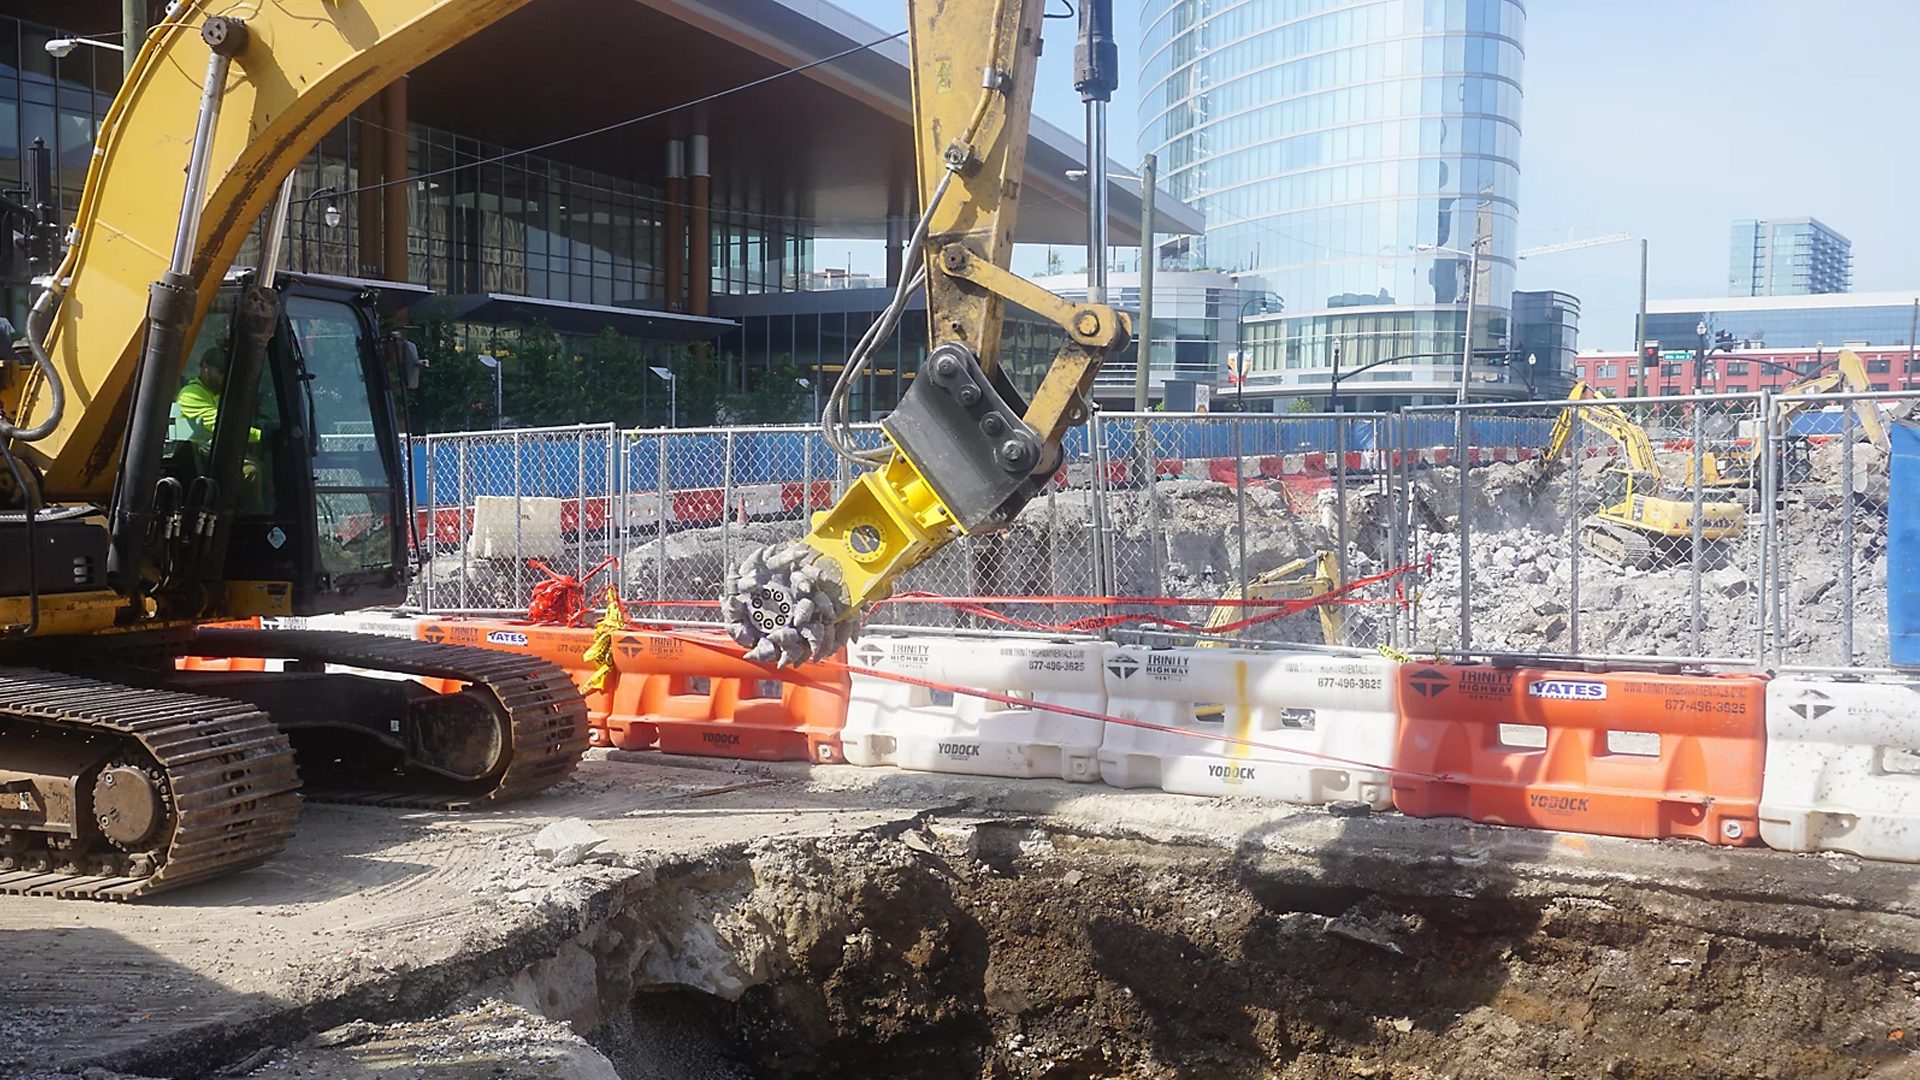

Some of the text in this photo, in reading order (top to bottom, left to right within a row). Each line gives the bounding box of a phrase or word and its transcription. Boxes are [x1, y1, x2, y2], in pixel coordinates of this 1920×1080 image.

[1686, 518, 1738, 529] KMATSU
[490, 633, 527, 644] YATES
[649, 636, 683, 646] TRINITY
[892, 643, 930, 654] TRINITY
[890, 654, 929, 662] HIGHWAY
[1148, 655, 1189, 666] TRINITY
[1029, 660, 1085, 671] 877-496-3625
[1146, 666, 1189, 675] HIGHWAY
[1461, 670, 1513, 683] TRINITY
[1318, 677, 1382, 690] 877-496-3625
[1458, 683, 1513, 694] HIGHWAY
[1534, 681, 1602, 697] YATES
[1664, 699, 1746, 714] 877-496-3625
[702, 732, 740, 745] YODOCK
[938, 743, 980, 756] YODOCK
[1208, 764, 1256, 780] YODOCK
[1530, 794, 1590, 812] YODOCK
